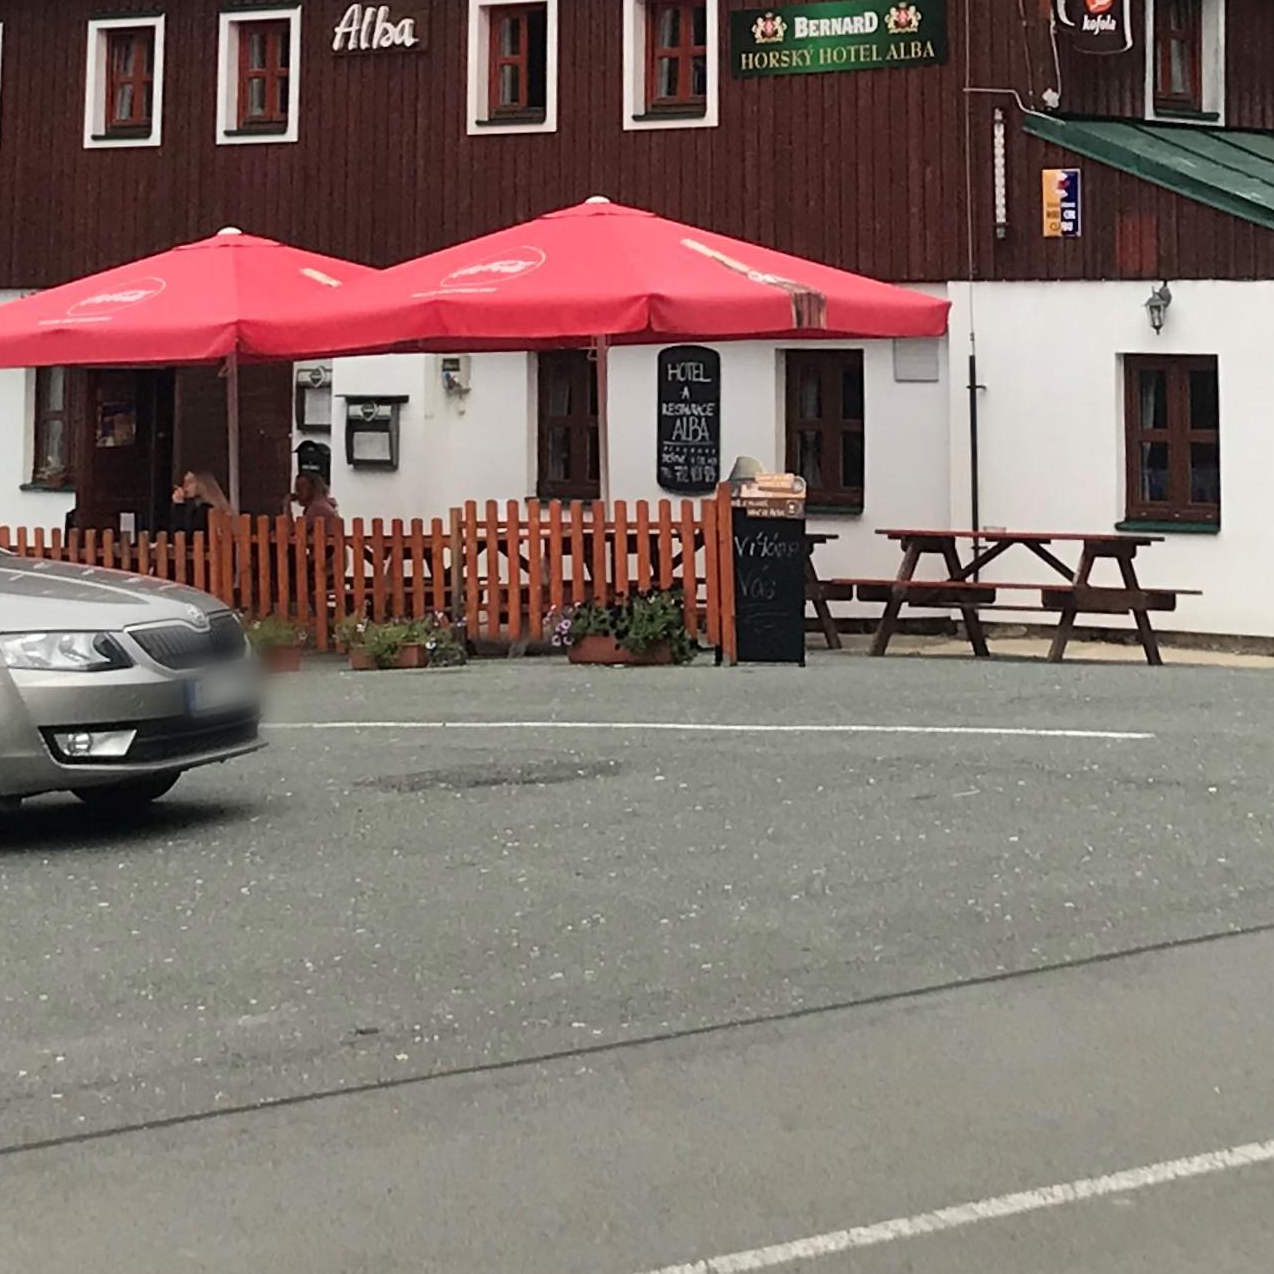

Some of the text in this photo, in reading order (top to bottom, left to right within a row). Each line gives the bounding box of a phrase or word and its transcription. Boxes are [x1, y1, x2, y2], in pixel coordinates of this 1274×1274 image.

[332, 4, 420, 51] Alba
[794, 11, 879, 39] BERNARD
[1082, 14, 1117, 35] kofola
[741, 40, 935, 71] HORSKÝ HOTEL ALBA
[667, 362, 712, 383] HOTEL
[672, 417, 710, 441] ALBA
